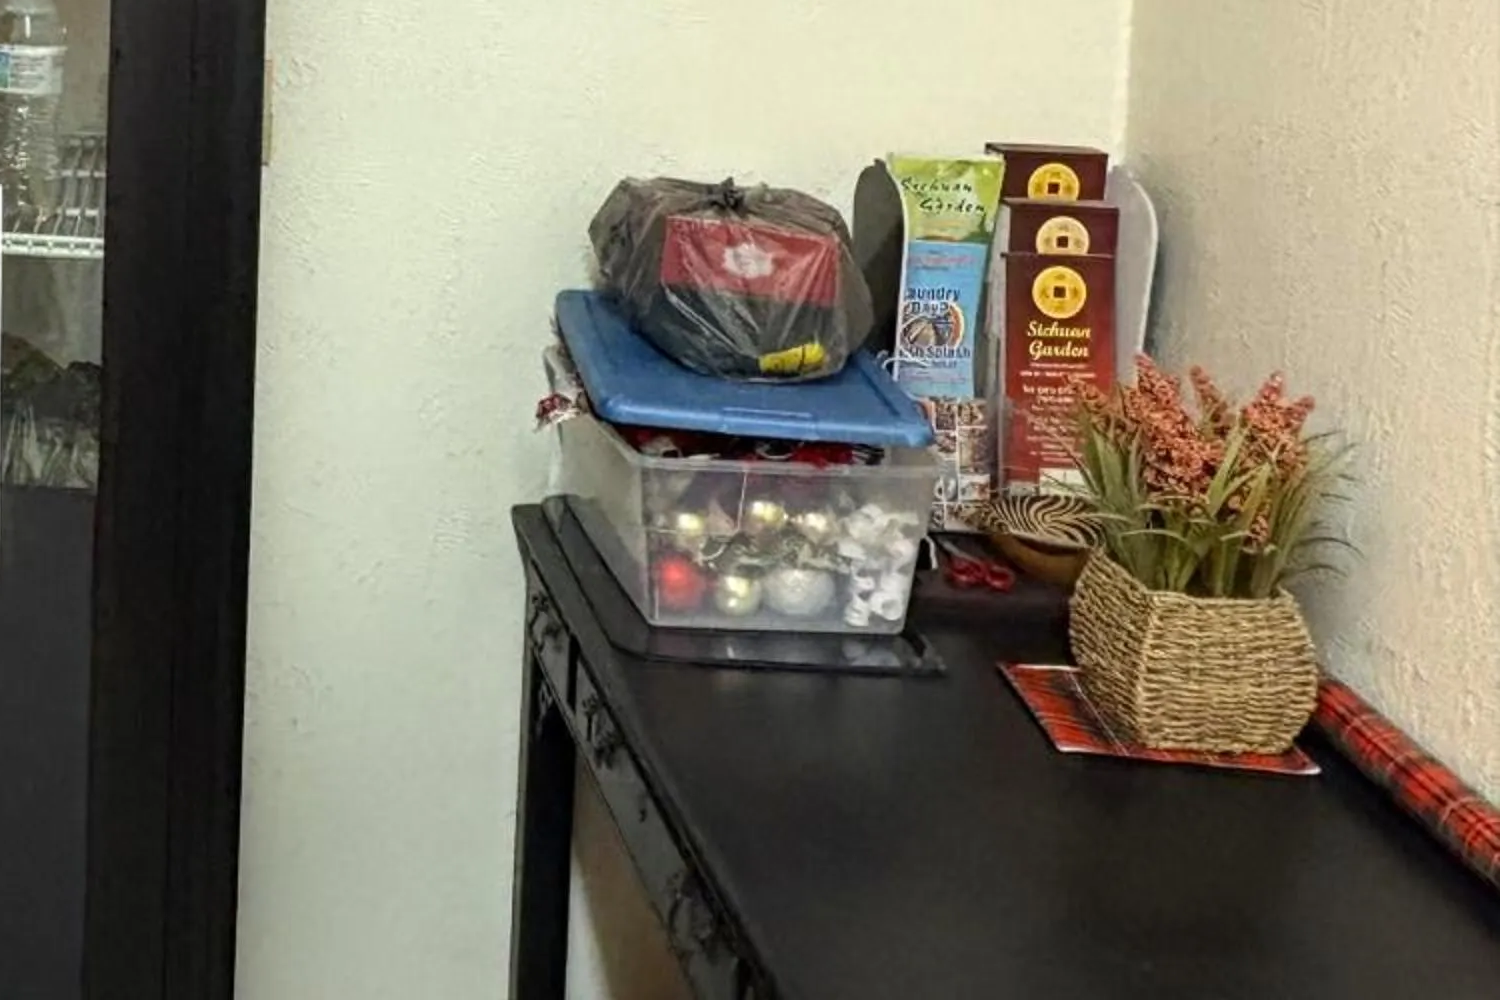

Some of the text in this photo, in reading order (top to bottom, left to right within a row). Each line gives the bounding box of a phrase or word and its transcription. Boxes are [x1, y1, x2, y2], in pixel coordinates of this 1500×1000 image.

[904, 287, 961, 302] aundry
[1027, 320, 1092, 339] Sichuan
[1029, 340, 1090, 361] Garden
